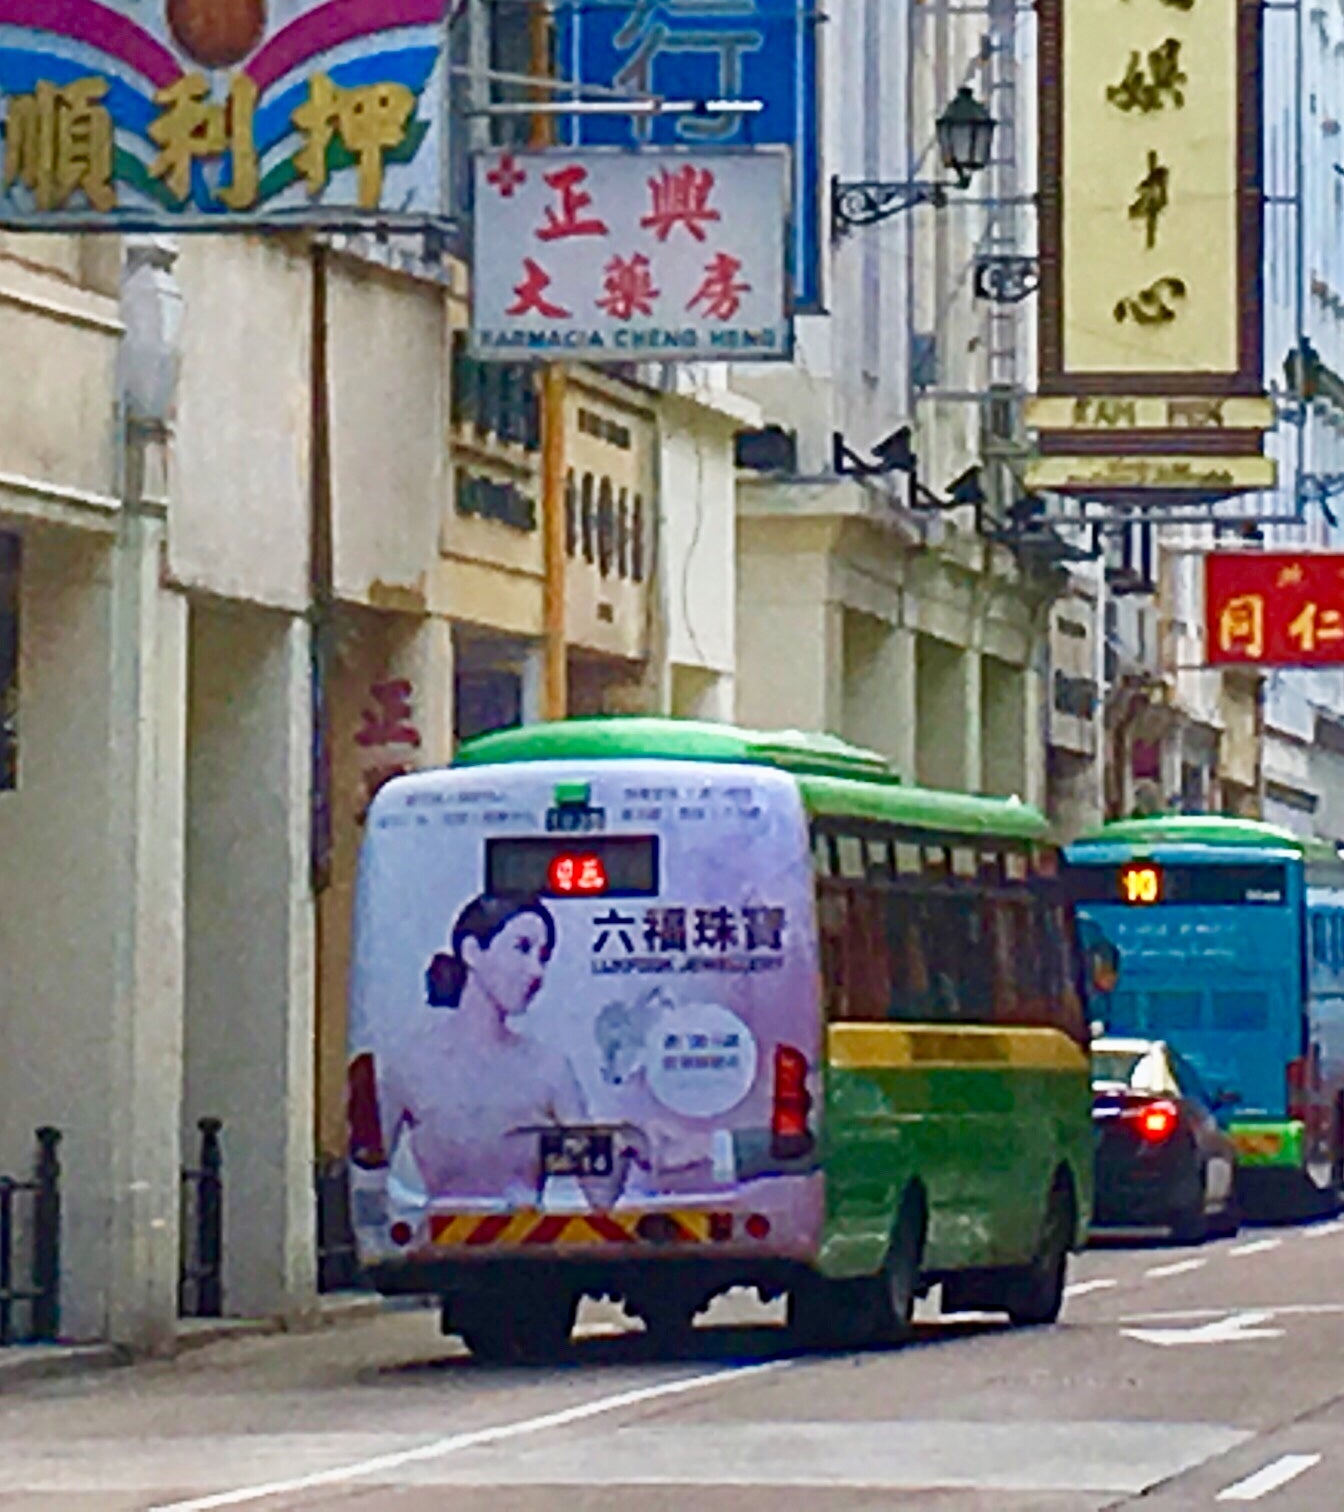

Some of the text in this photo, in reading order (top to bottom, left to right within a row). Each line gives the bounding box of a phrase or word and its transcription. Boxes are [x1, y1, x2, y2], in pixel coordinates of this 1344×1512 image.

[4, 71, 416, 213] 順利押
[535, 163, 721, 243] 正興
[504, 251, 752, 322] 大藥房
[592, 904, 786, 953] 六福珠寶
